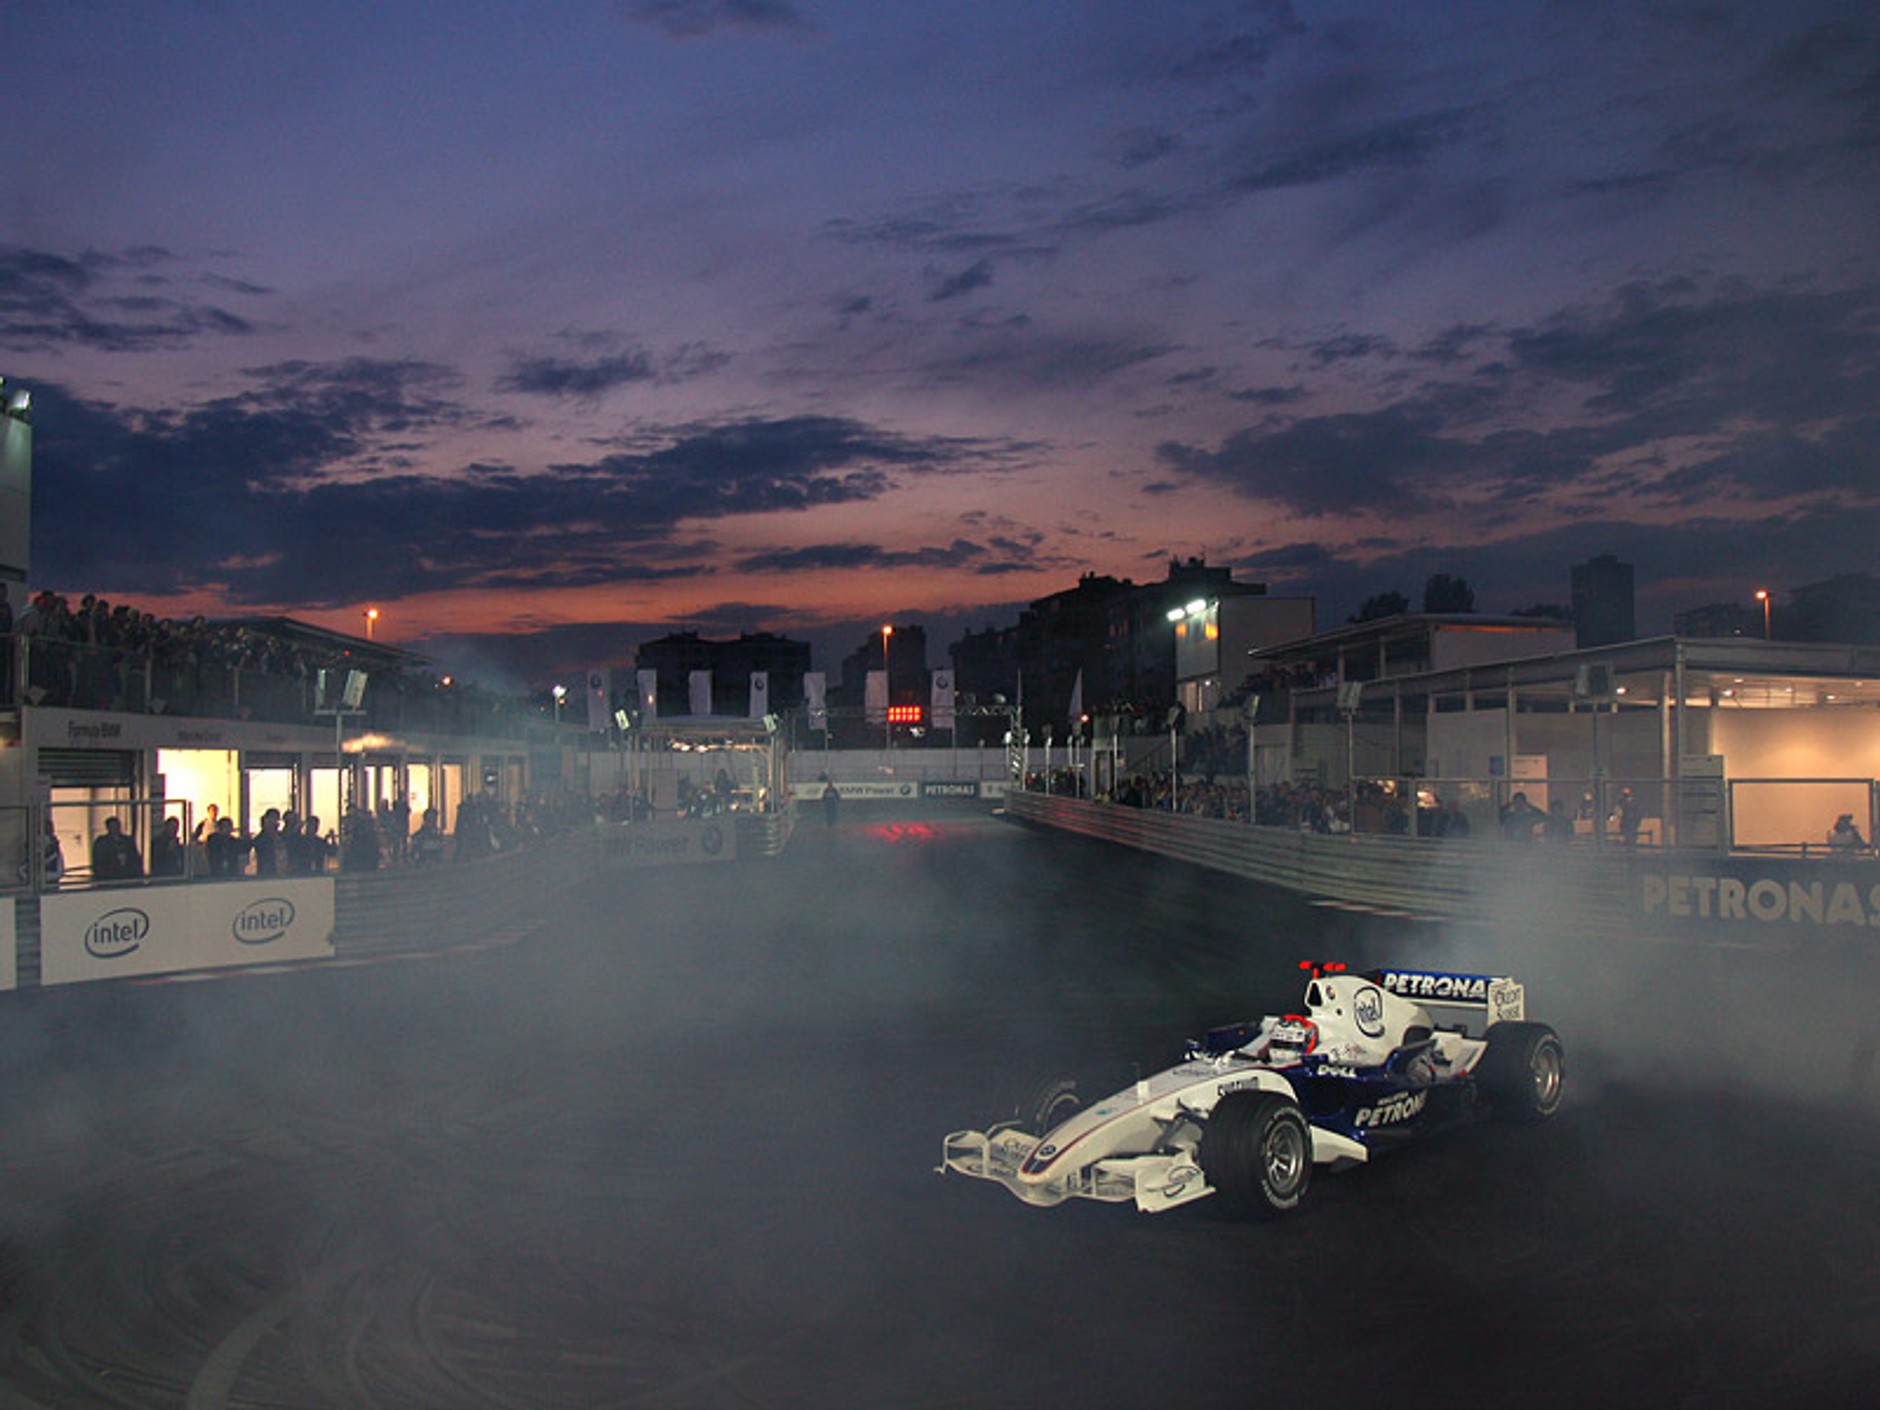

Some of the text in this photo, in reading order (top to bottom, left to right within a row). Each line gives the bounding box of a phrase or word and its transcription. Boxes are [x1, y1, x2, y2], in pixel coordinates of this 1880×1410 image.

[925, 783, 975, 795] PETRONAS
[93, 917, 139, 944] intel
[240, 908, 286, 931] intel
